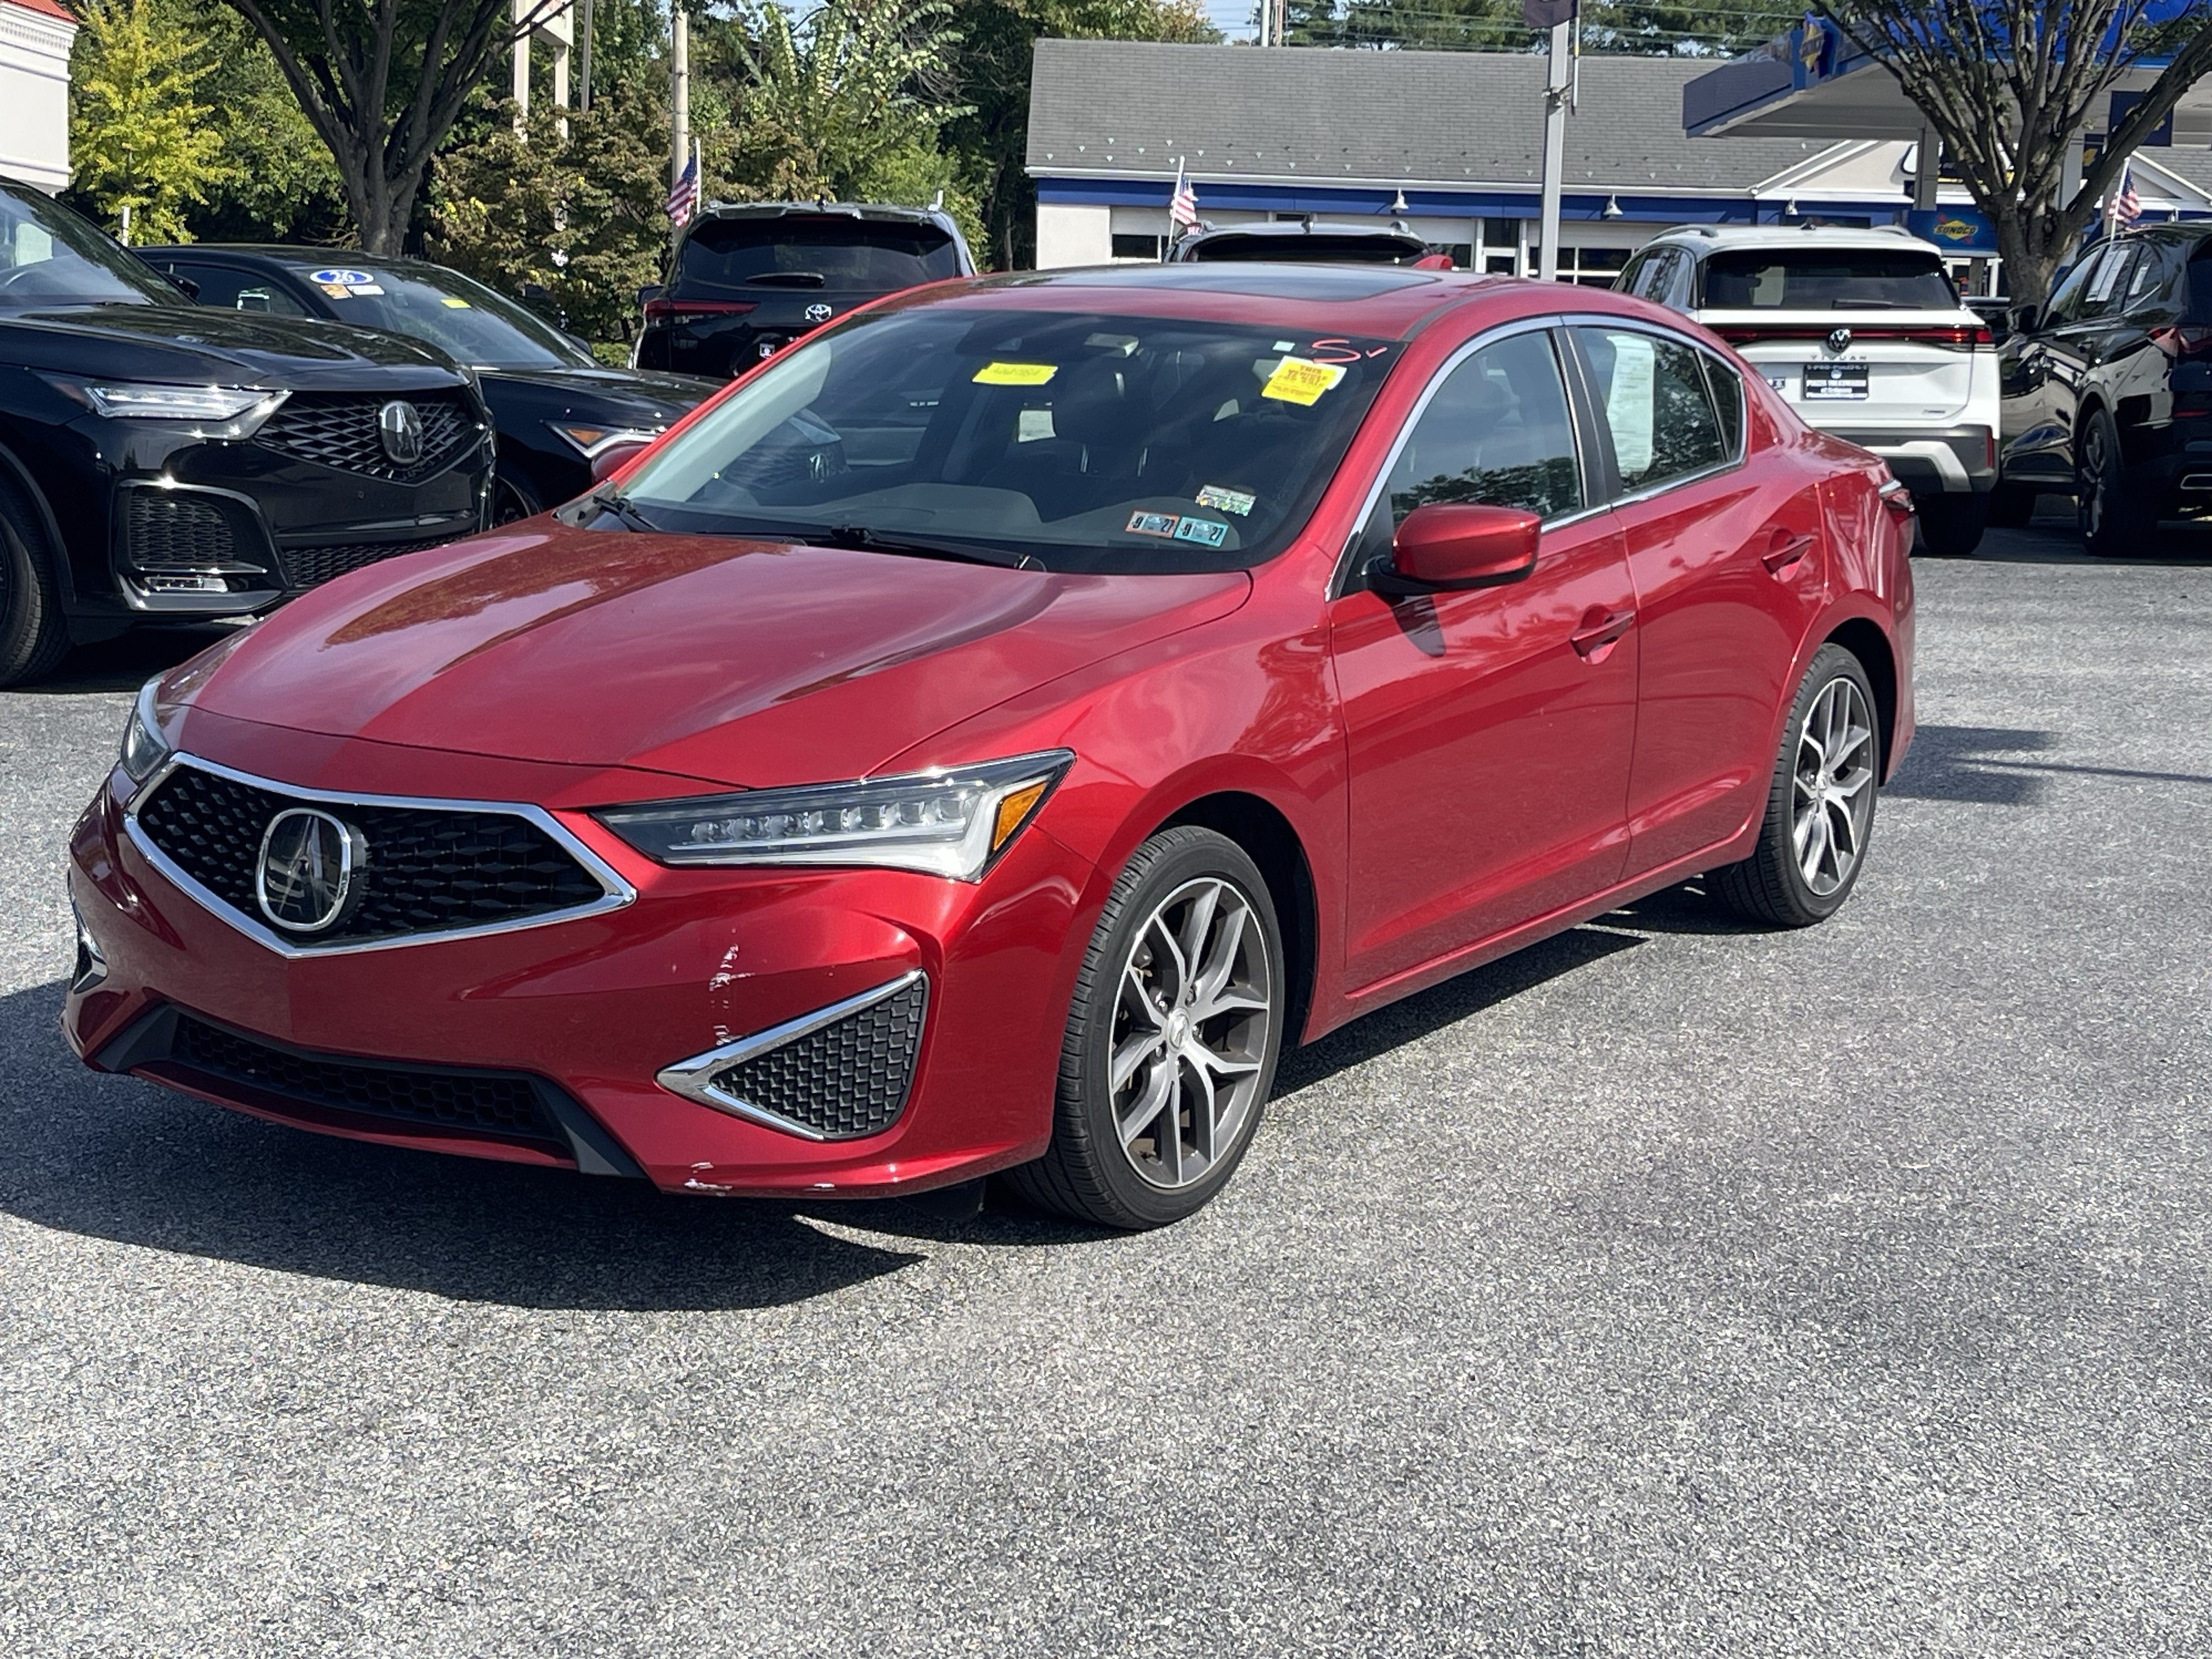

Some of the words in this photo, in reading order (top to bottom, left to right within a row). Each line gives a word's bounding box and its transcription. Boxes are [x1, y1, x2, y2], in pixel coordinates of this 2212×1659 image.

[1936, 225, 1977, 234] SUNOCO
[329, 271, 356, 283] 26
[1160, 518, 1176, 533] 27
[1182, 523, 1193, 538] 9
[1209, 526, 1224, 541] 27
